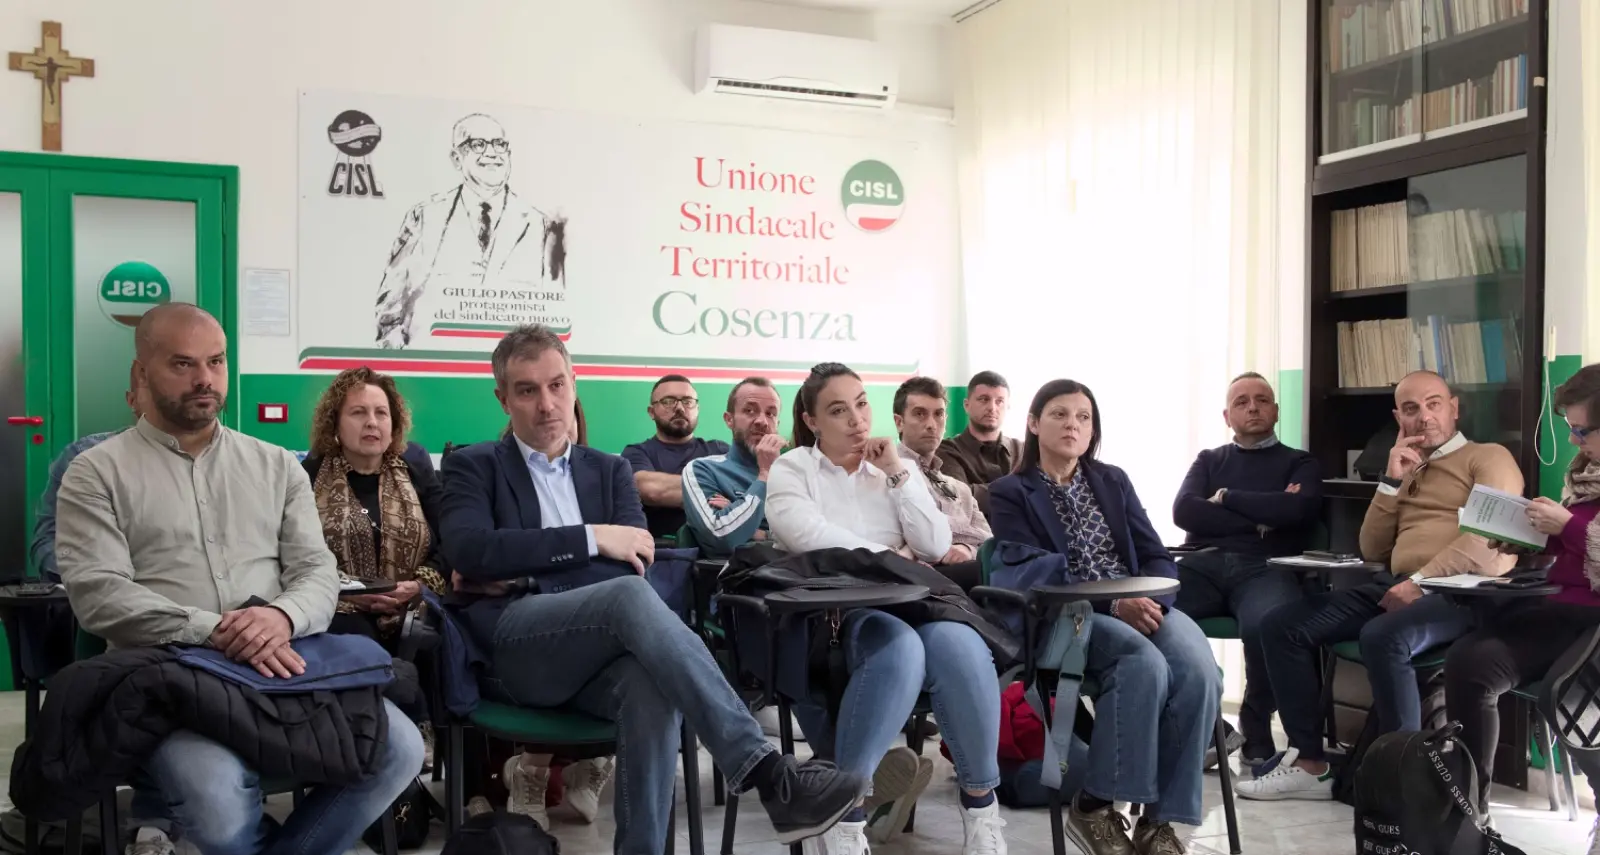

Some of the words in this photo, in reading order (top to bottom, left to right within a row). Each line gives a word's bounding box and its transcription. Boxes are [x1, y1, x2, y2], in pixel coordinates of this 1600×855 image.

[328, 162, 383, 196] CISL
[693, 156, 816, 195] Unione
[849, 179, 898, 199] CISL
[679, 201, 835, 240] Sindacale
[660, 245, 850, 285] Territoriale
[443, 287, 497, 299] GIULIO
[500, 289, 565, 302] PASTORE
[459, 300, 546, 312] protagonista
[434, 309, 455, 320] del
[459, 309, 525, 322] sindacato
[528, 315, 571, 324] nuovo
[652, 290, 857, 341] Cosenza
[1428, 750, 1452, 782] GUESS
[1450, 785, 1473, 816] GUESS
[1378, 824, 1401, 835] GUES
